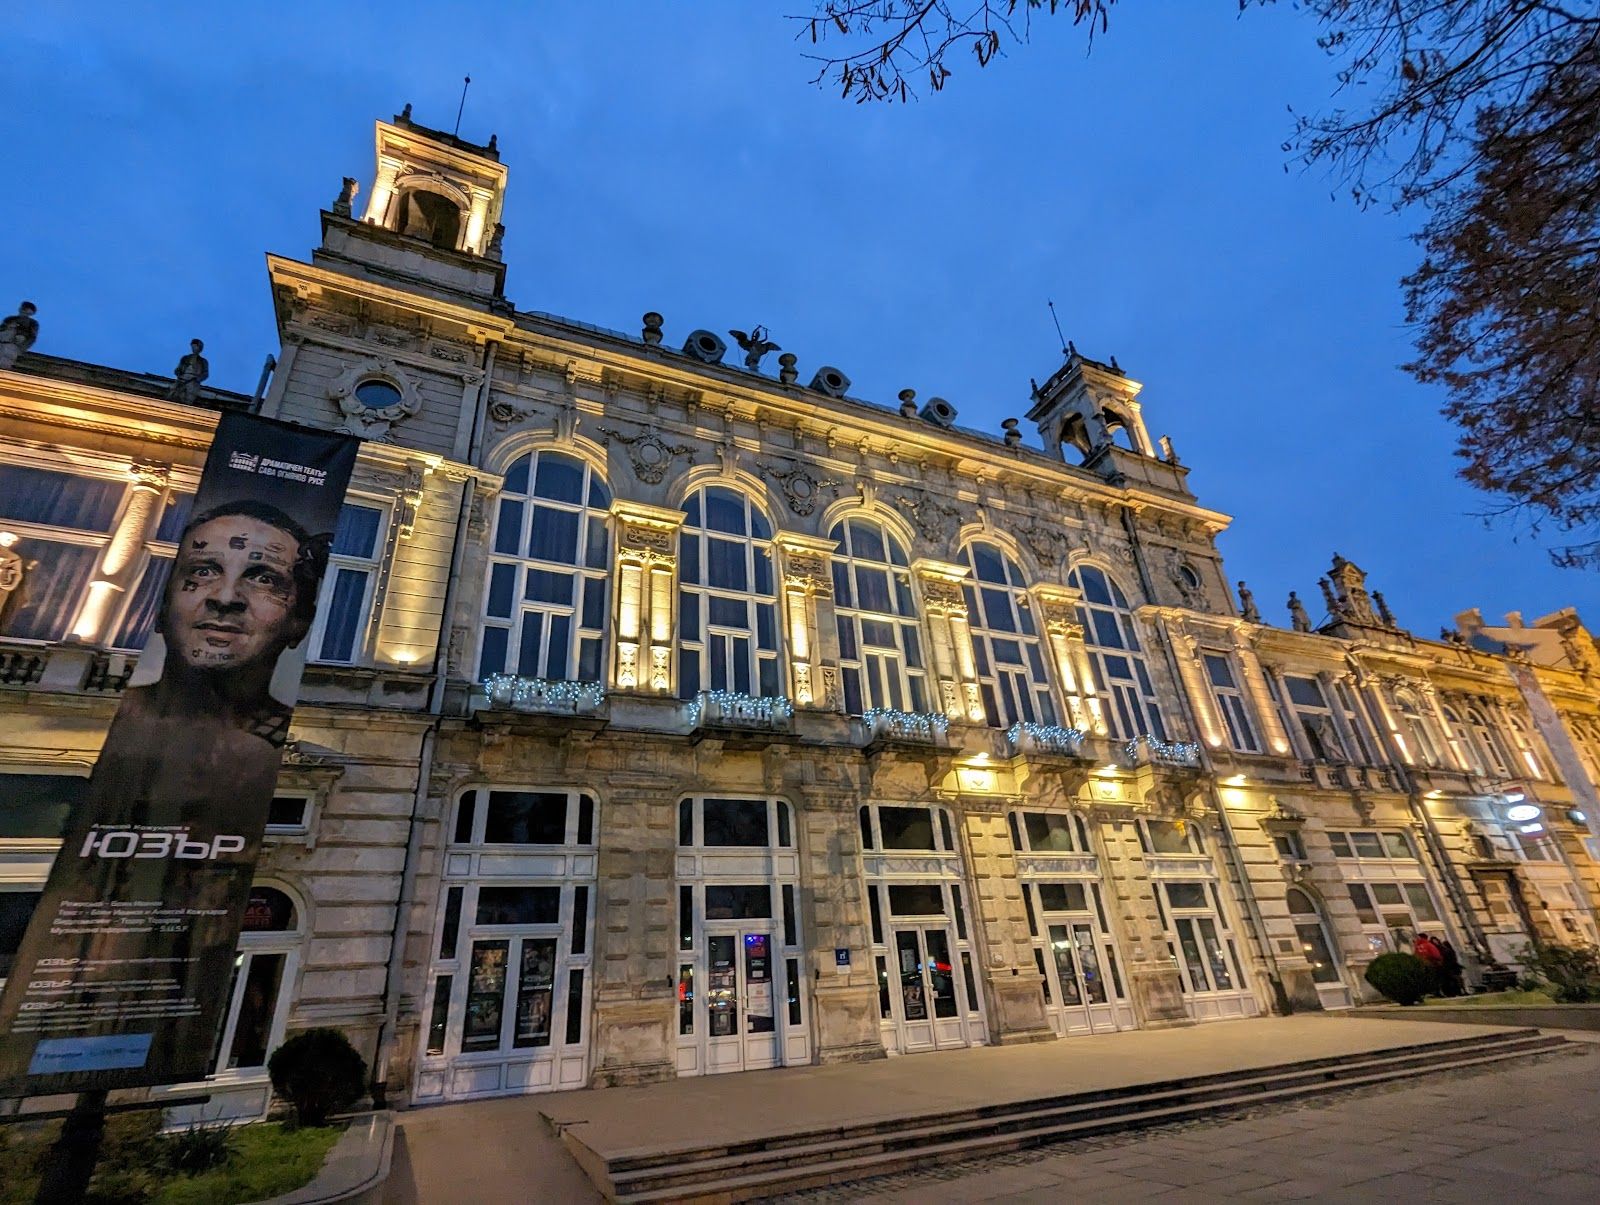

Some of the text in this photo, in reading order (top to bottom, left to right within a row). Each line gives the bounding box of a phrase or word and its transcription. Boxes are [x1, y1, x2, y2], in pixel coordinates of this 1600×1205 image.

[258, 466, 276, 476] САВА
[307, 476, 325, 486] РУСЕ
[261, 458, 328, 478] ДРАМАТИЧЕН ТЕАТЪР
[79, 831, 245, 860] ЮЗЪР
[38, 958, 80, 967] ЮЗЪР
[29, 980, 72, 989] ЮЗЪР
